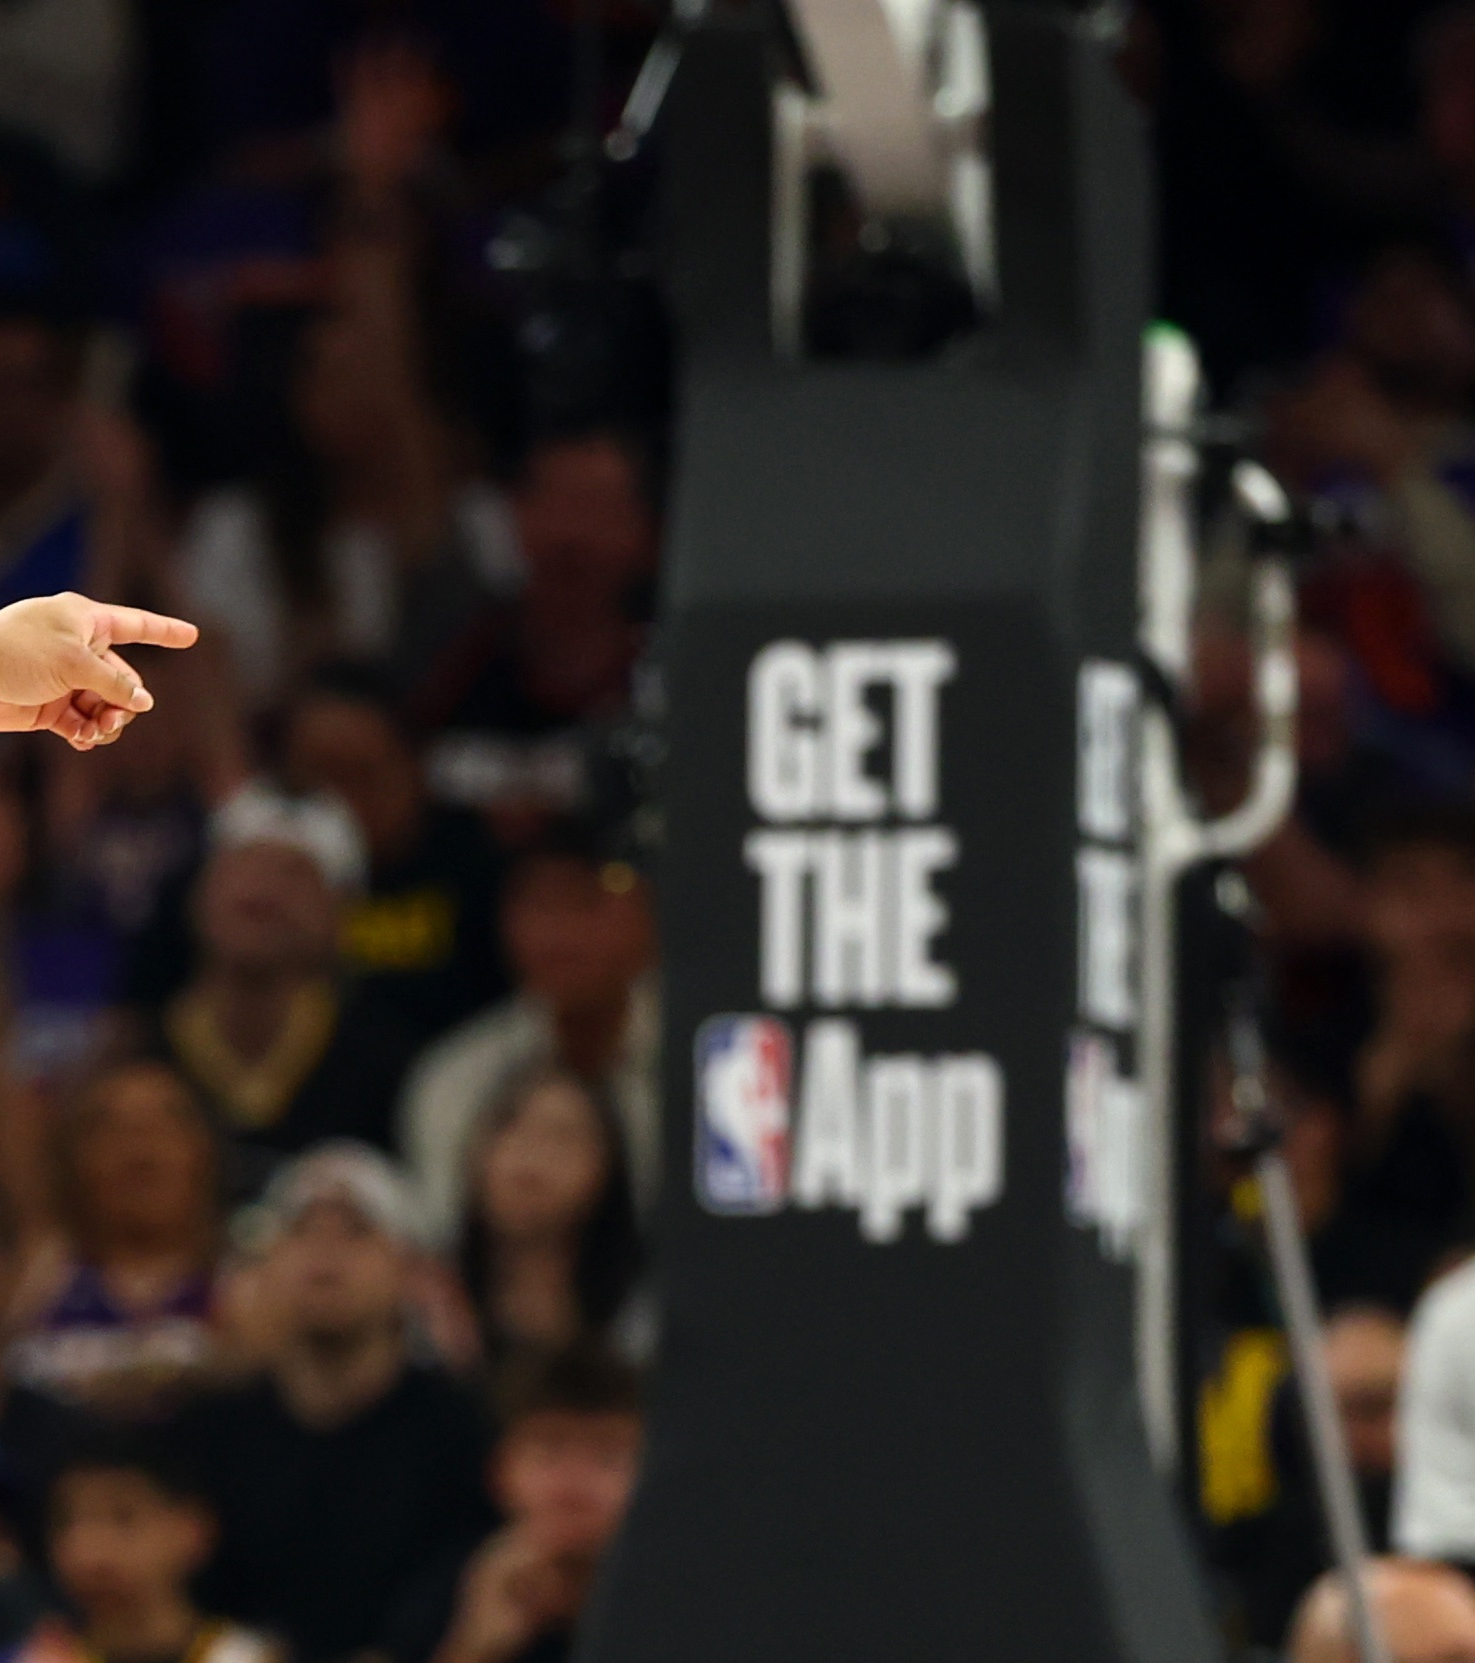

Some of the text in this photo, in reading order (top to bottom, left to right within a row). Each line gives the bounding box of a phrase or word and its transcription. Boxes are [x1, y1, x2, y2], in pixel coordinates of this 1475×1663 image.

[748, 639, 957, 821] GET
[744, 828, 959, 1007] THE
[791, 1017, 1005, 1244] App
